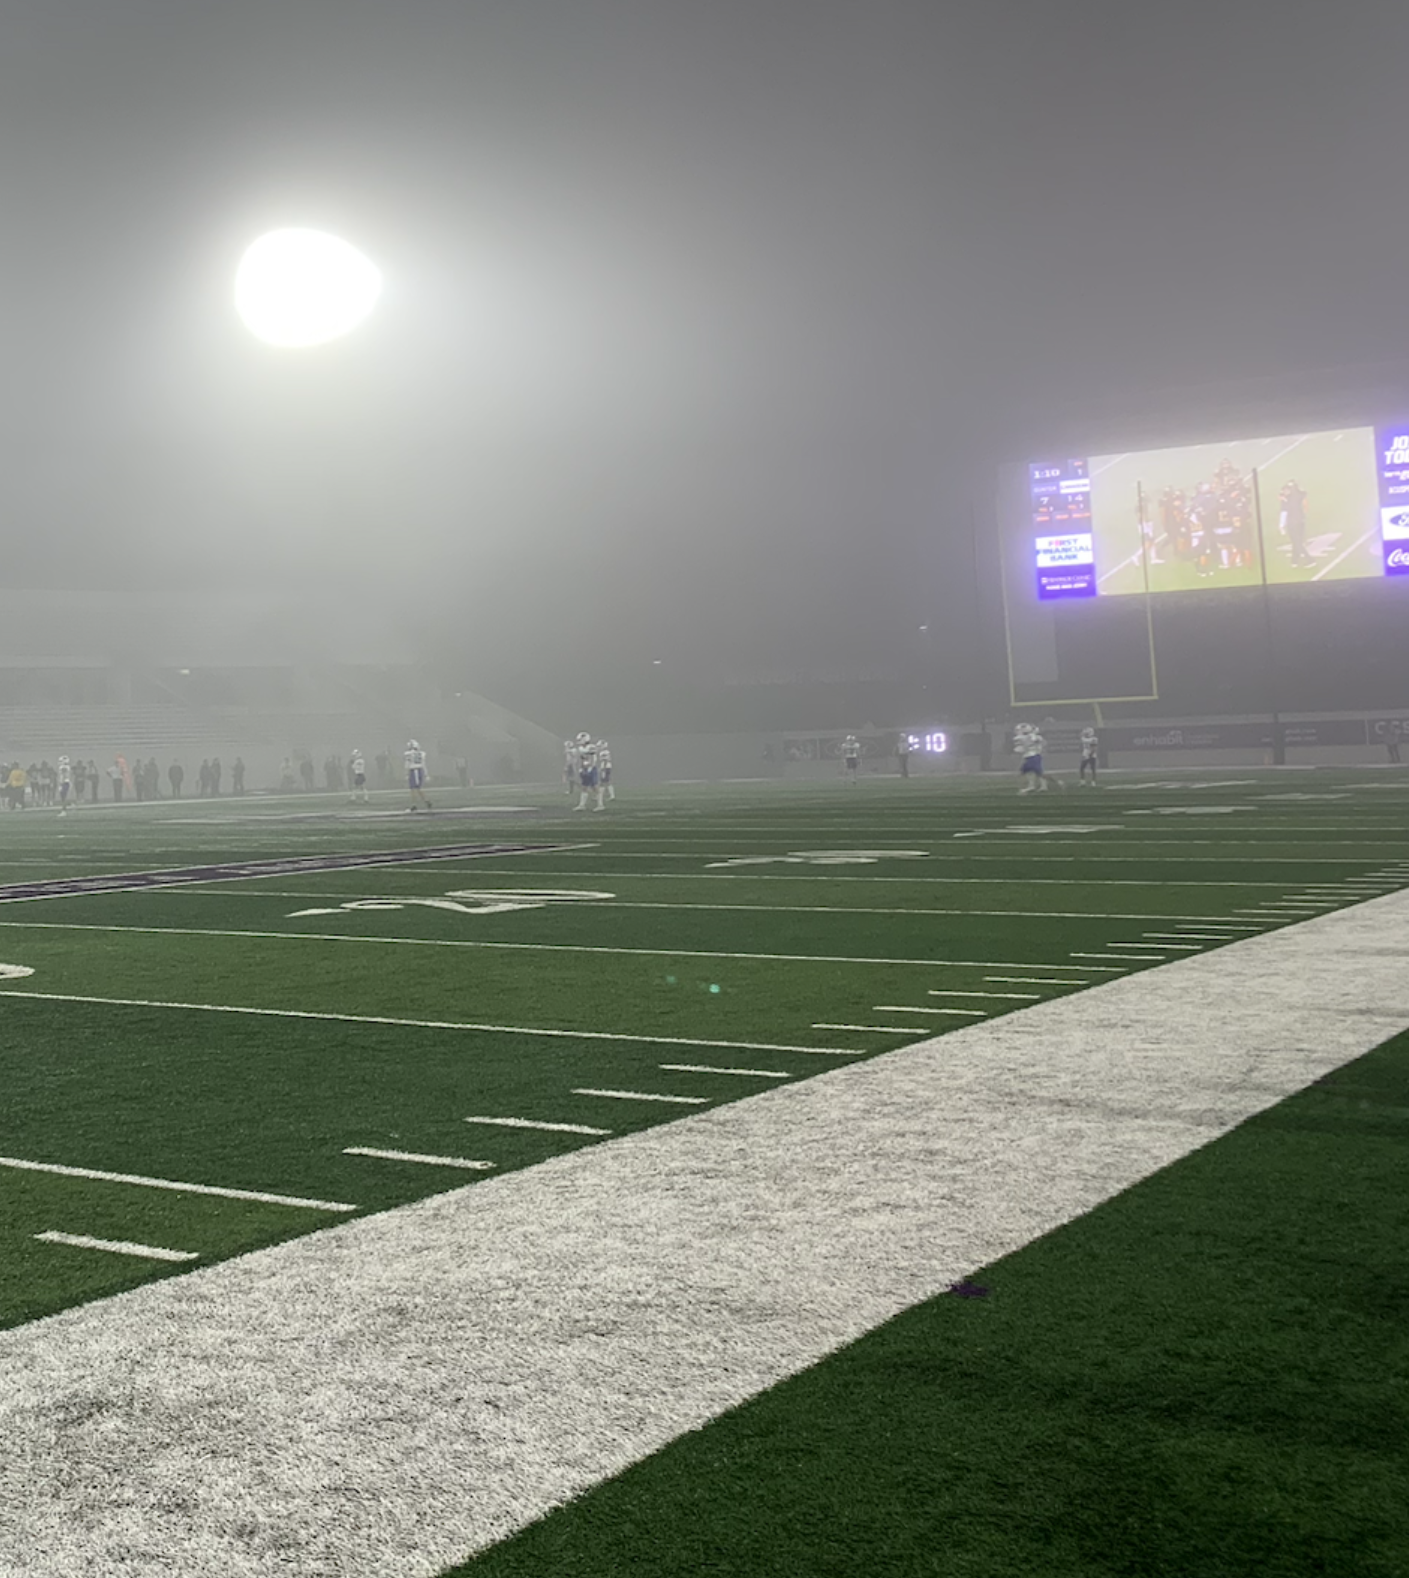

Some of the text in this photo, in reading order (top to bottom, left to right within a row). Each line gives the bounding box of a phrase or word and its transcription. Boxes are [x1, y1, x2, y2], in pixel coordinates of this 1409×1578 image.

[1033, 469, 1061, 479] 1:10
[1040, 496, 1050, 504] 7
[1049, 553, 1078, 561] BANK
[1133, 734, 1184, 746] enhabit
[340, 888, 616, 914] 20
